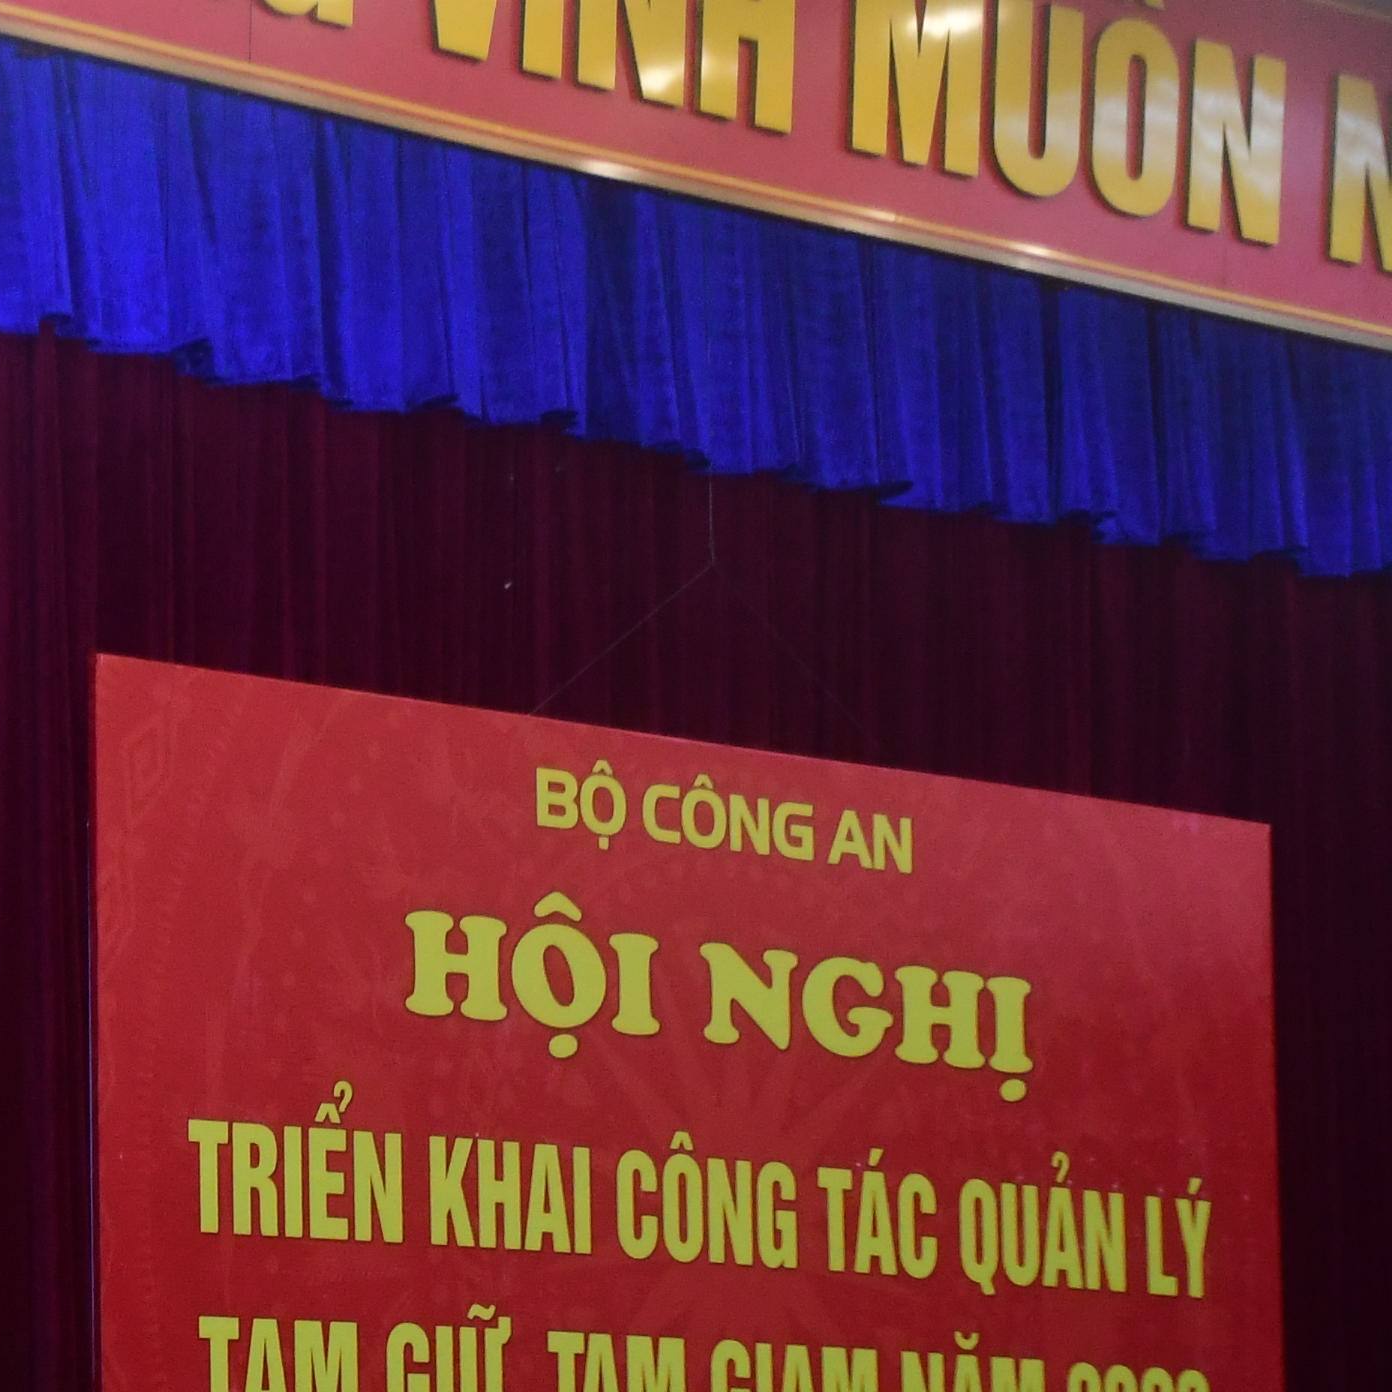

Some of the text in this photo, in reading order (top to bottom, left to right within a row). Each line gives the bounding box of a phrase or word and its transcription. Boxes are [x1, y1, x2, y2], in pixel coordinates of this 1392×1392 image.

[535, 759, 914, 874] BỘ CÔNG AN
[404, 891, 1033, 1102] HỘI NGHỊ
[187, 1080, 1211, 1298] TRIỂN KHAI CÔNG TÁC QUẢN LÝ
